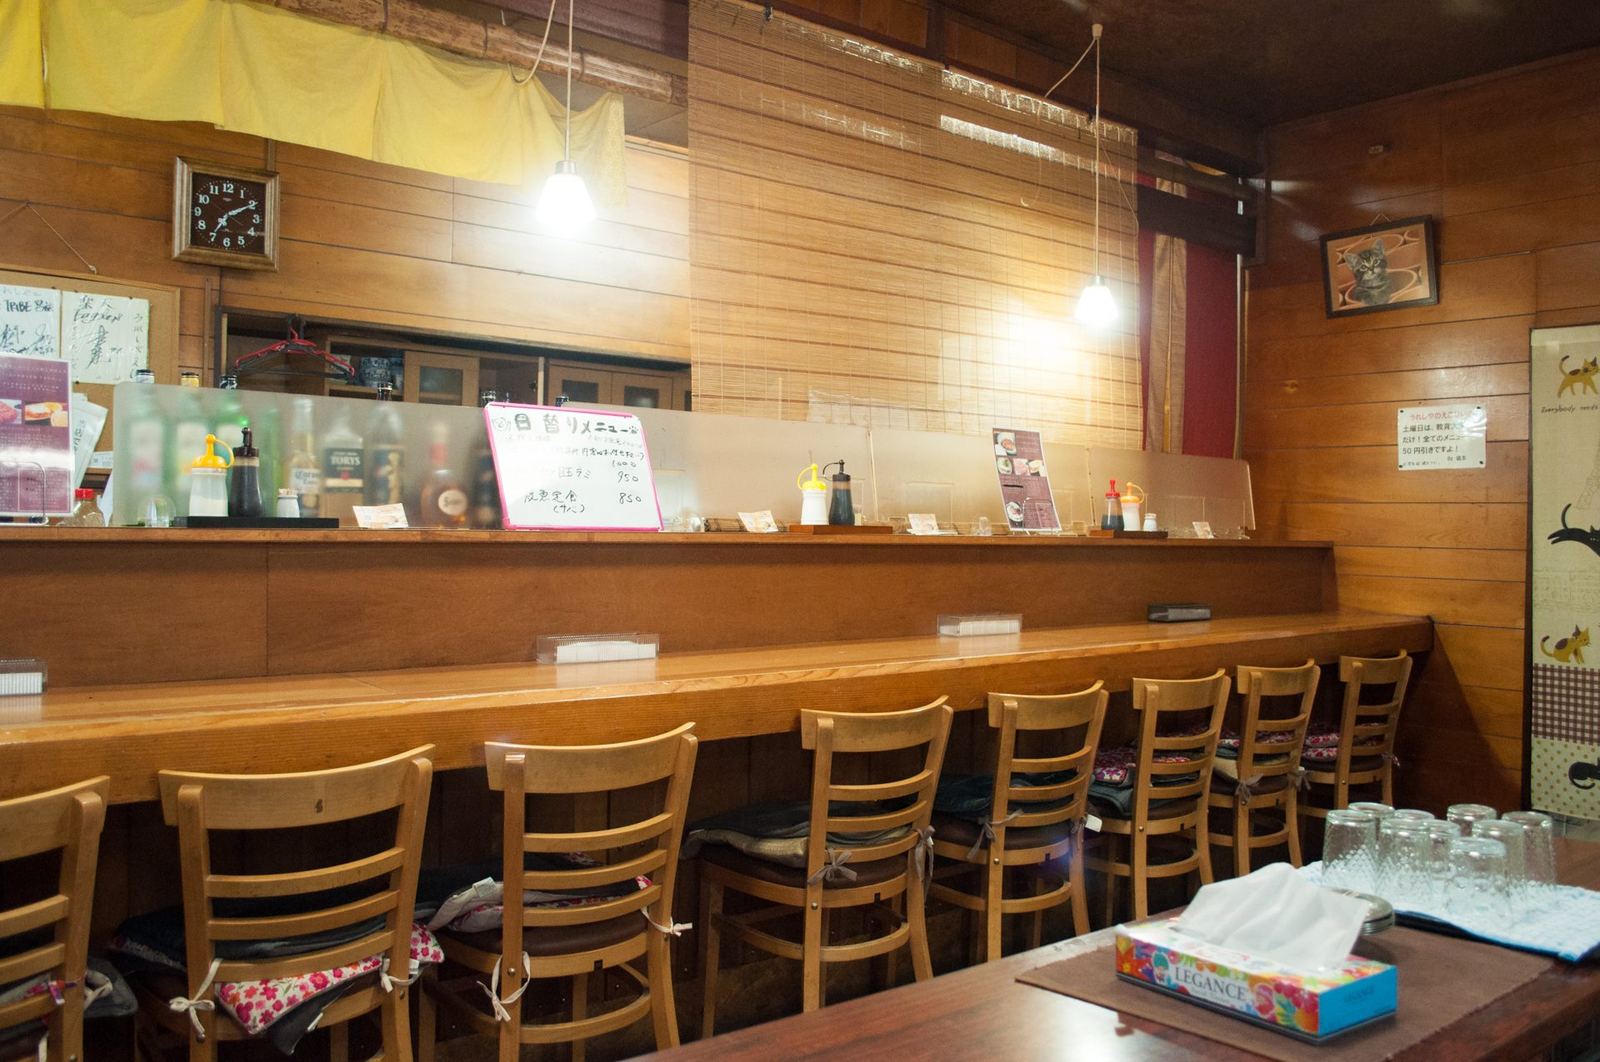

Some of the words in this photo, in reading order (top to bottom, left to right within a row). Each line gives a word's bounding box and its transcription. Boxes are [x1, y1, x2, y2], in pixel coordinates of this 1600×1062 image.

[210, 186, 219, 195] 11
[223, 183, 234, 193] 12
[240, 190, 245, 199] 1
[199, 195, 210, 204] 10
[194, 207, 202, 216] 9
[253, 215, 260, 224] 3
[198, 220, 206, 230] 8
[248, 227, 256, 235] 4
[209, 232, 217, 242] 7
[238, 236, 245, 245] 5
[223, 238, 231, 247] 6
[330, 456, 361, 466] TORYS
[619, 492, 642, 505] 850
[1175, 966, 1248, 1001] LEGANCE
